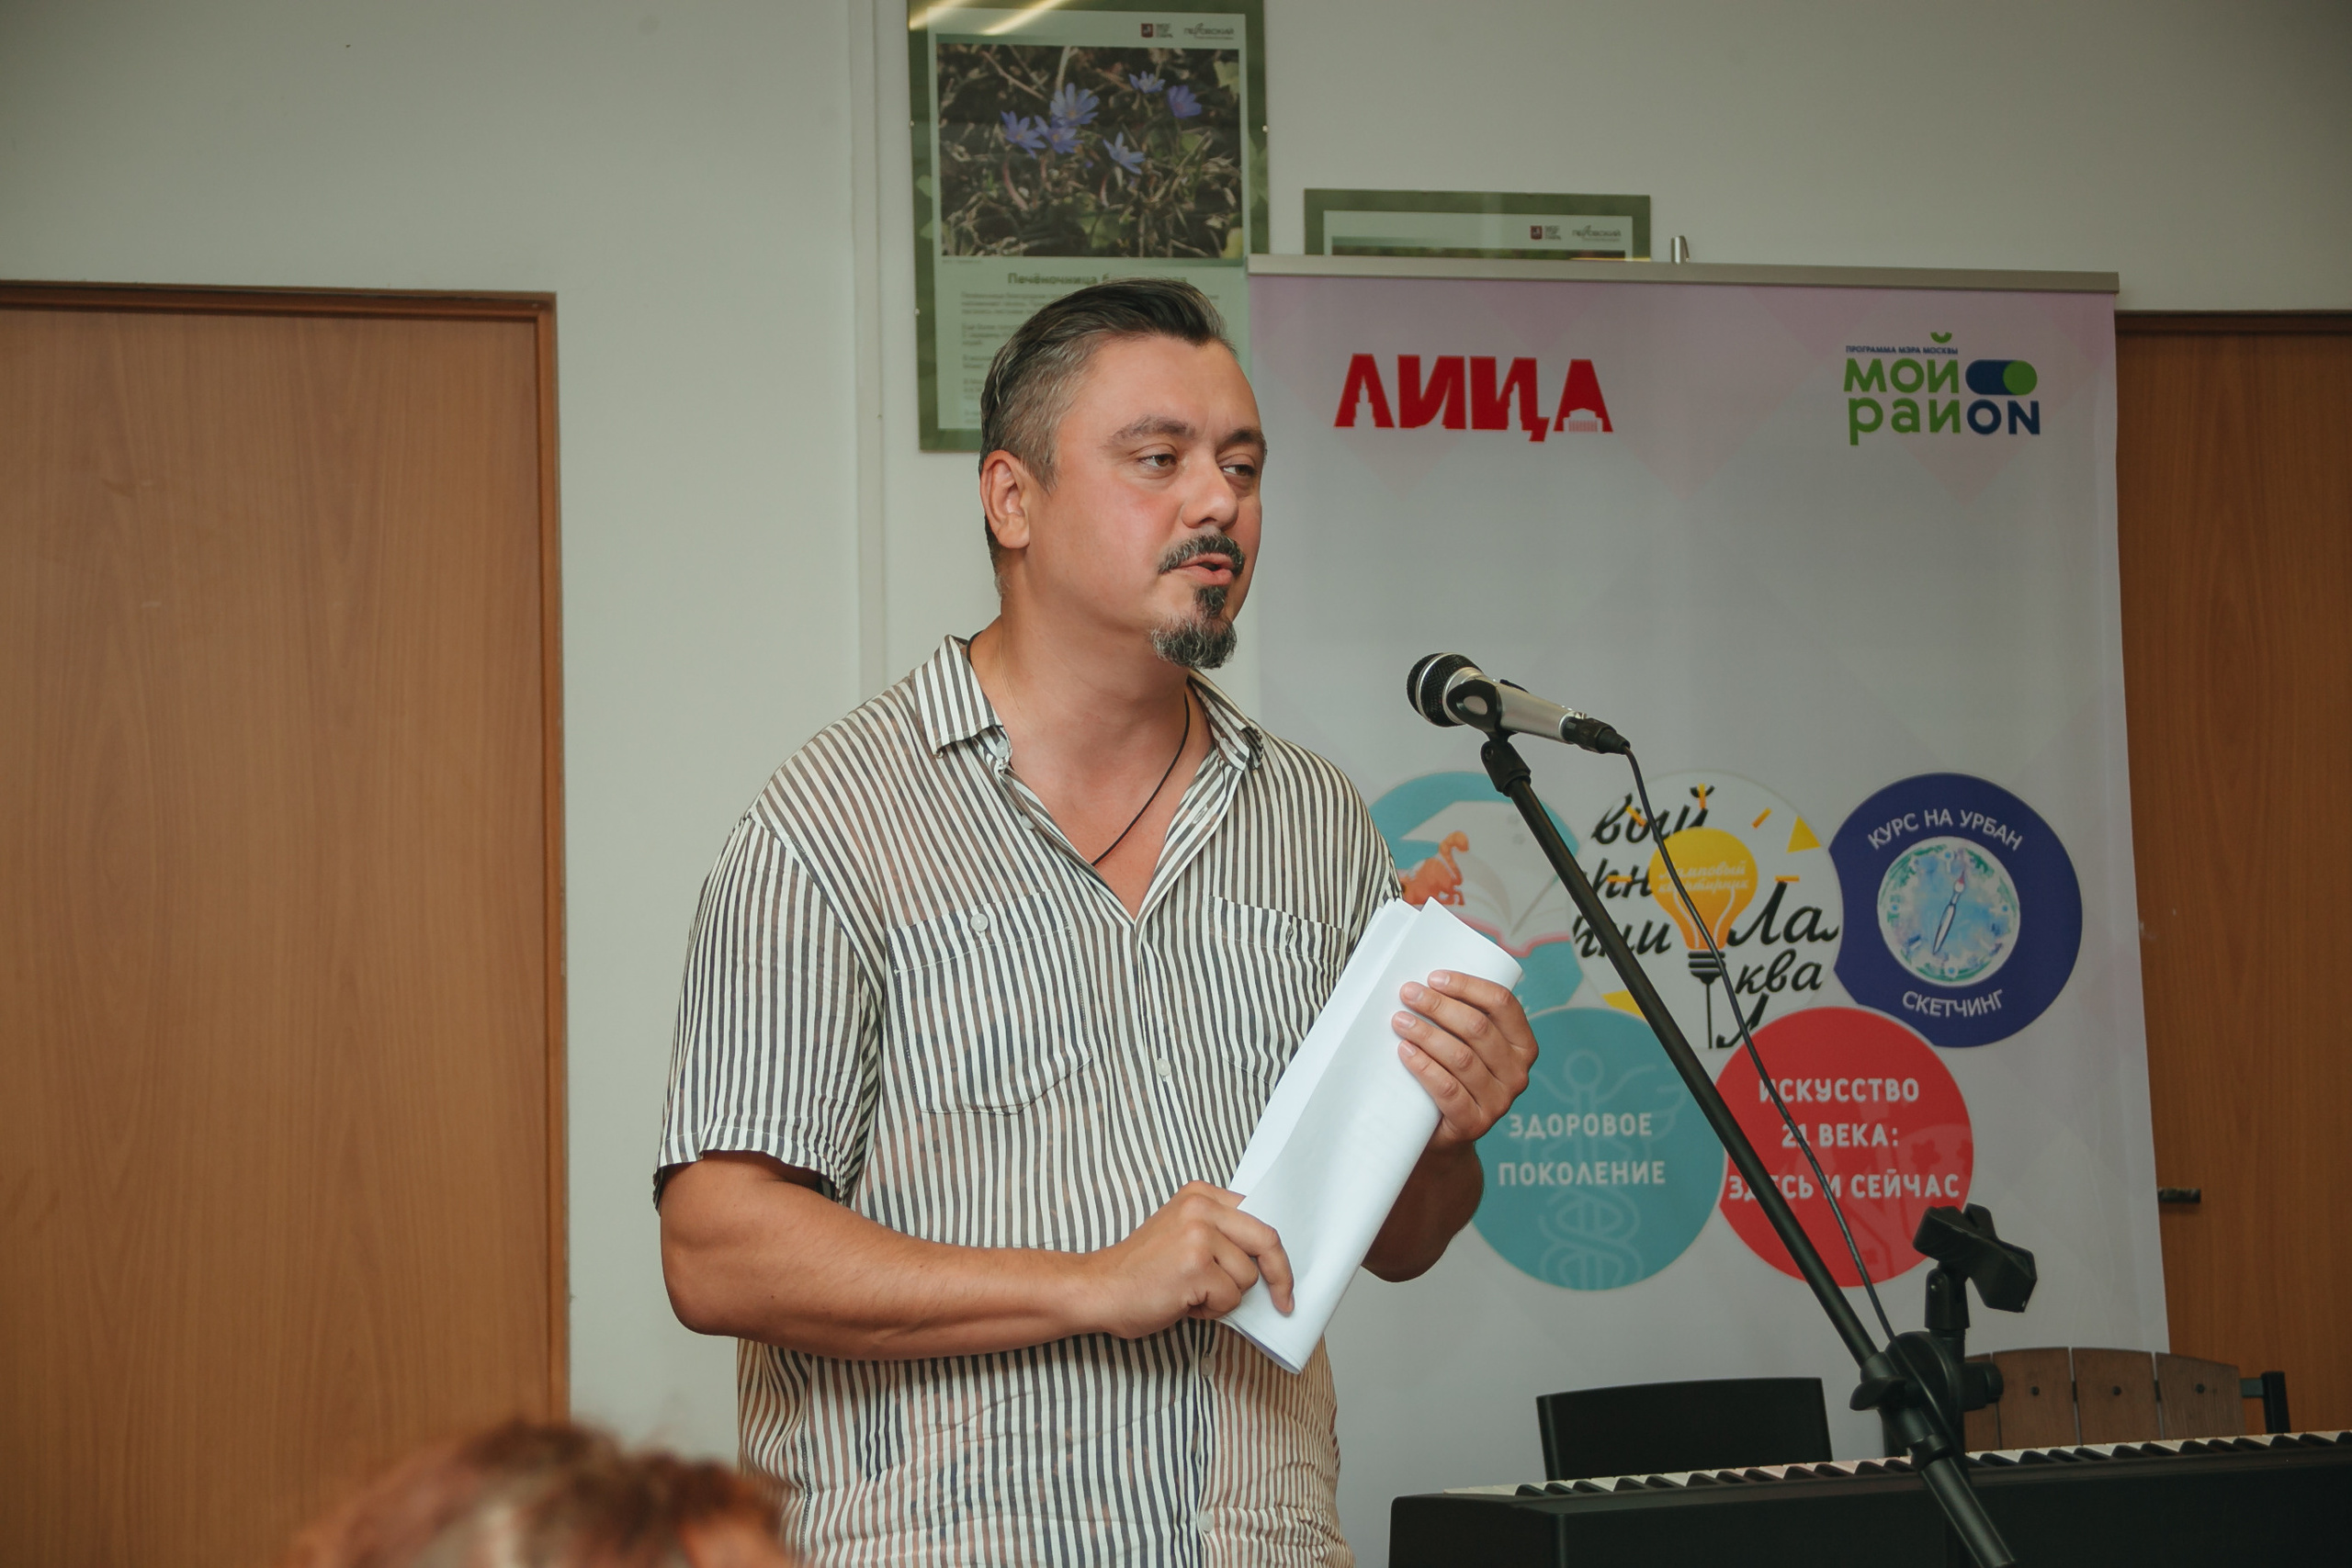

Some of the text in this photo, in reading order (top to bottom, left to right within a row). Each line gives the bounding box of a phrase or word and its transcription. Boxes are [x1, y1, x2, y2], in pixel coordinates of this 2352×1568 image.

[1846, 345, 1959, 355] ПРОГРАММА МЭРА МОСКВЫ
[1333, 353, 1613, 443] ЛИЦА
[1868, 808, 2023, 852] КУРС НА УРБАН
[1735, 948, 1823, 995] ква
[1902, 988, 2004, 1018] СКЕТЧИНГ
[1758, 1077, 1920, 1103] ИСКУССТВО
[1509, 1112, 1652, 1140] ЗДОРОВОЕ
[1781, 1122, 1899, 1148] 21 ВЕКА:
[1498, 1160, 1666, 1186] ПОКОЛЕНИЕ
[1727, 1174, 1814, 1201] ЗСЬ
[1850, 1168, 1960, 1200] СЕЙЧАС
